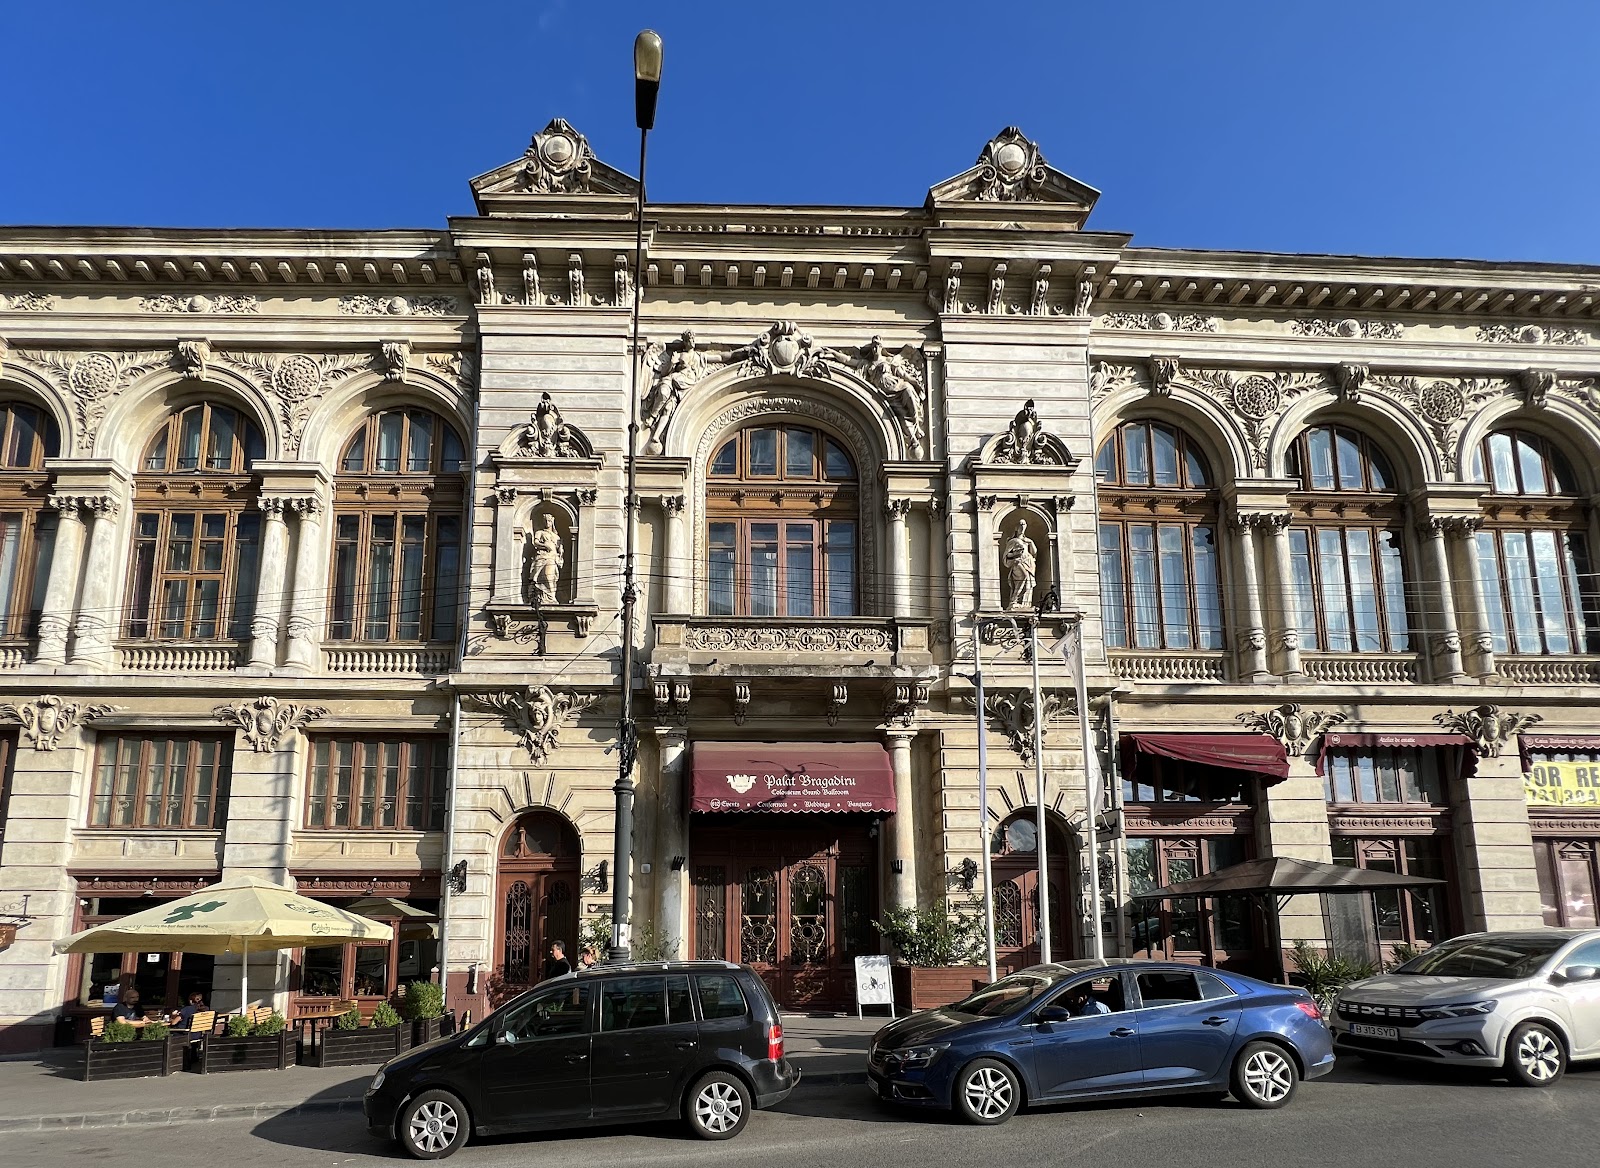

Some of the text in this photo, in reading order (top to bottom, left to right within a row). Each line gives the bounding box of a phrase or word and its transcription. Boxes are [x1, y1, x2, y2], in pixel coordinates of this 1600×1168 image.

[763, 774, 857, 789] Palat Bragadiru
[802, 788, 821, 796] Grand
[822, 788, 850, 796] Ballroom
[847, 801, 873, 809] Banquets
[1356, 1025, 1396, 1038] B 313 SYD
